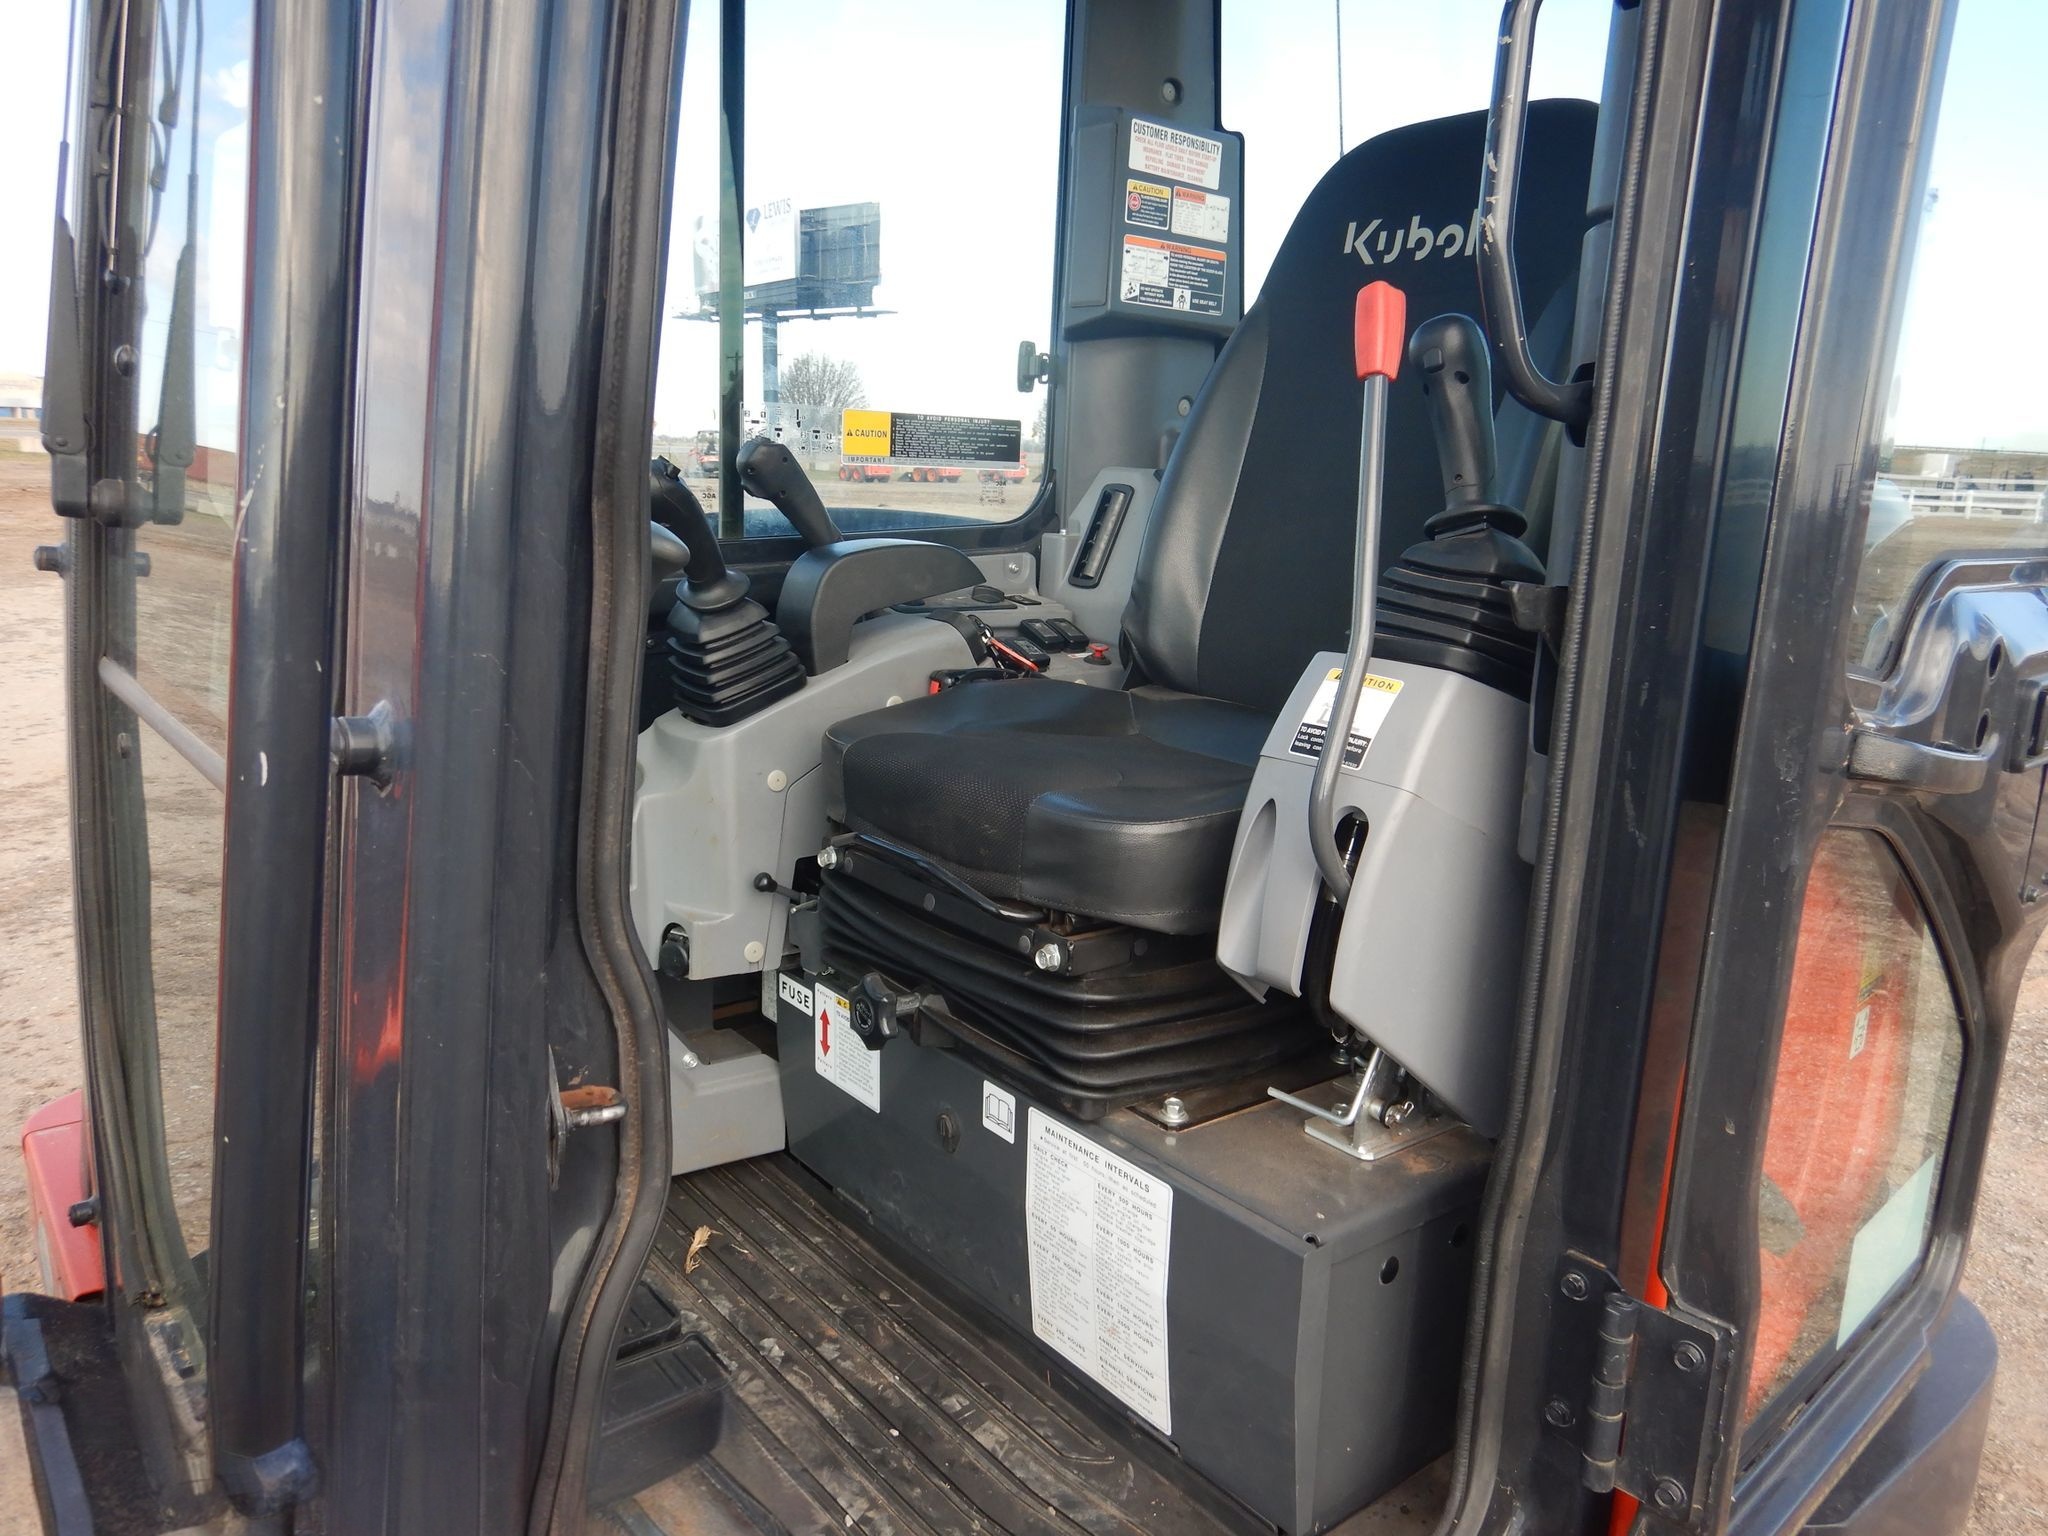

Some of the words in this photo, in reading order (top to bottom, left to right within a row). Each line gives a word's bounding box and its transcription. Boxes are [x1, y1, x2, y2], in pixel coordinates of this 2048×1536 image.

[1133, 122, 1168, 142] CUSTOMER
[1170, 132, 1220, 156] RESPONSIBILITY
[1139, 185, 1164, 196] CAUTION
[763, 198, 791, 220] LEWIS
[1343, 208, 1479, 265] Kubo
[854, 429, 888, 438] CAUTION
[847, 456, 886, 464] IMPORTANT
[782, 981, 809, 1009] FUSE
[1045, 1126, 1100, 1164] MAINTENANCE
[1104, 1160, 1150, 1193] INTERVALS
[1050, 1154, 1068, 1168] CHECK
[1097, 1183, 1115, 1197] EVERY
[1132, 1204, 1153, 1220] HOURS
[1031, 1212, 1047, 1225] EVERY
[1059, 1231, 1077, 1246] HOURS
[1096, 1223, 1113, 1237] EVERY
[1133, 1247, 1154, 1264] HOURS
